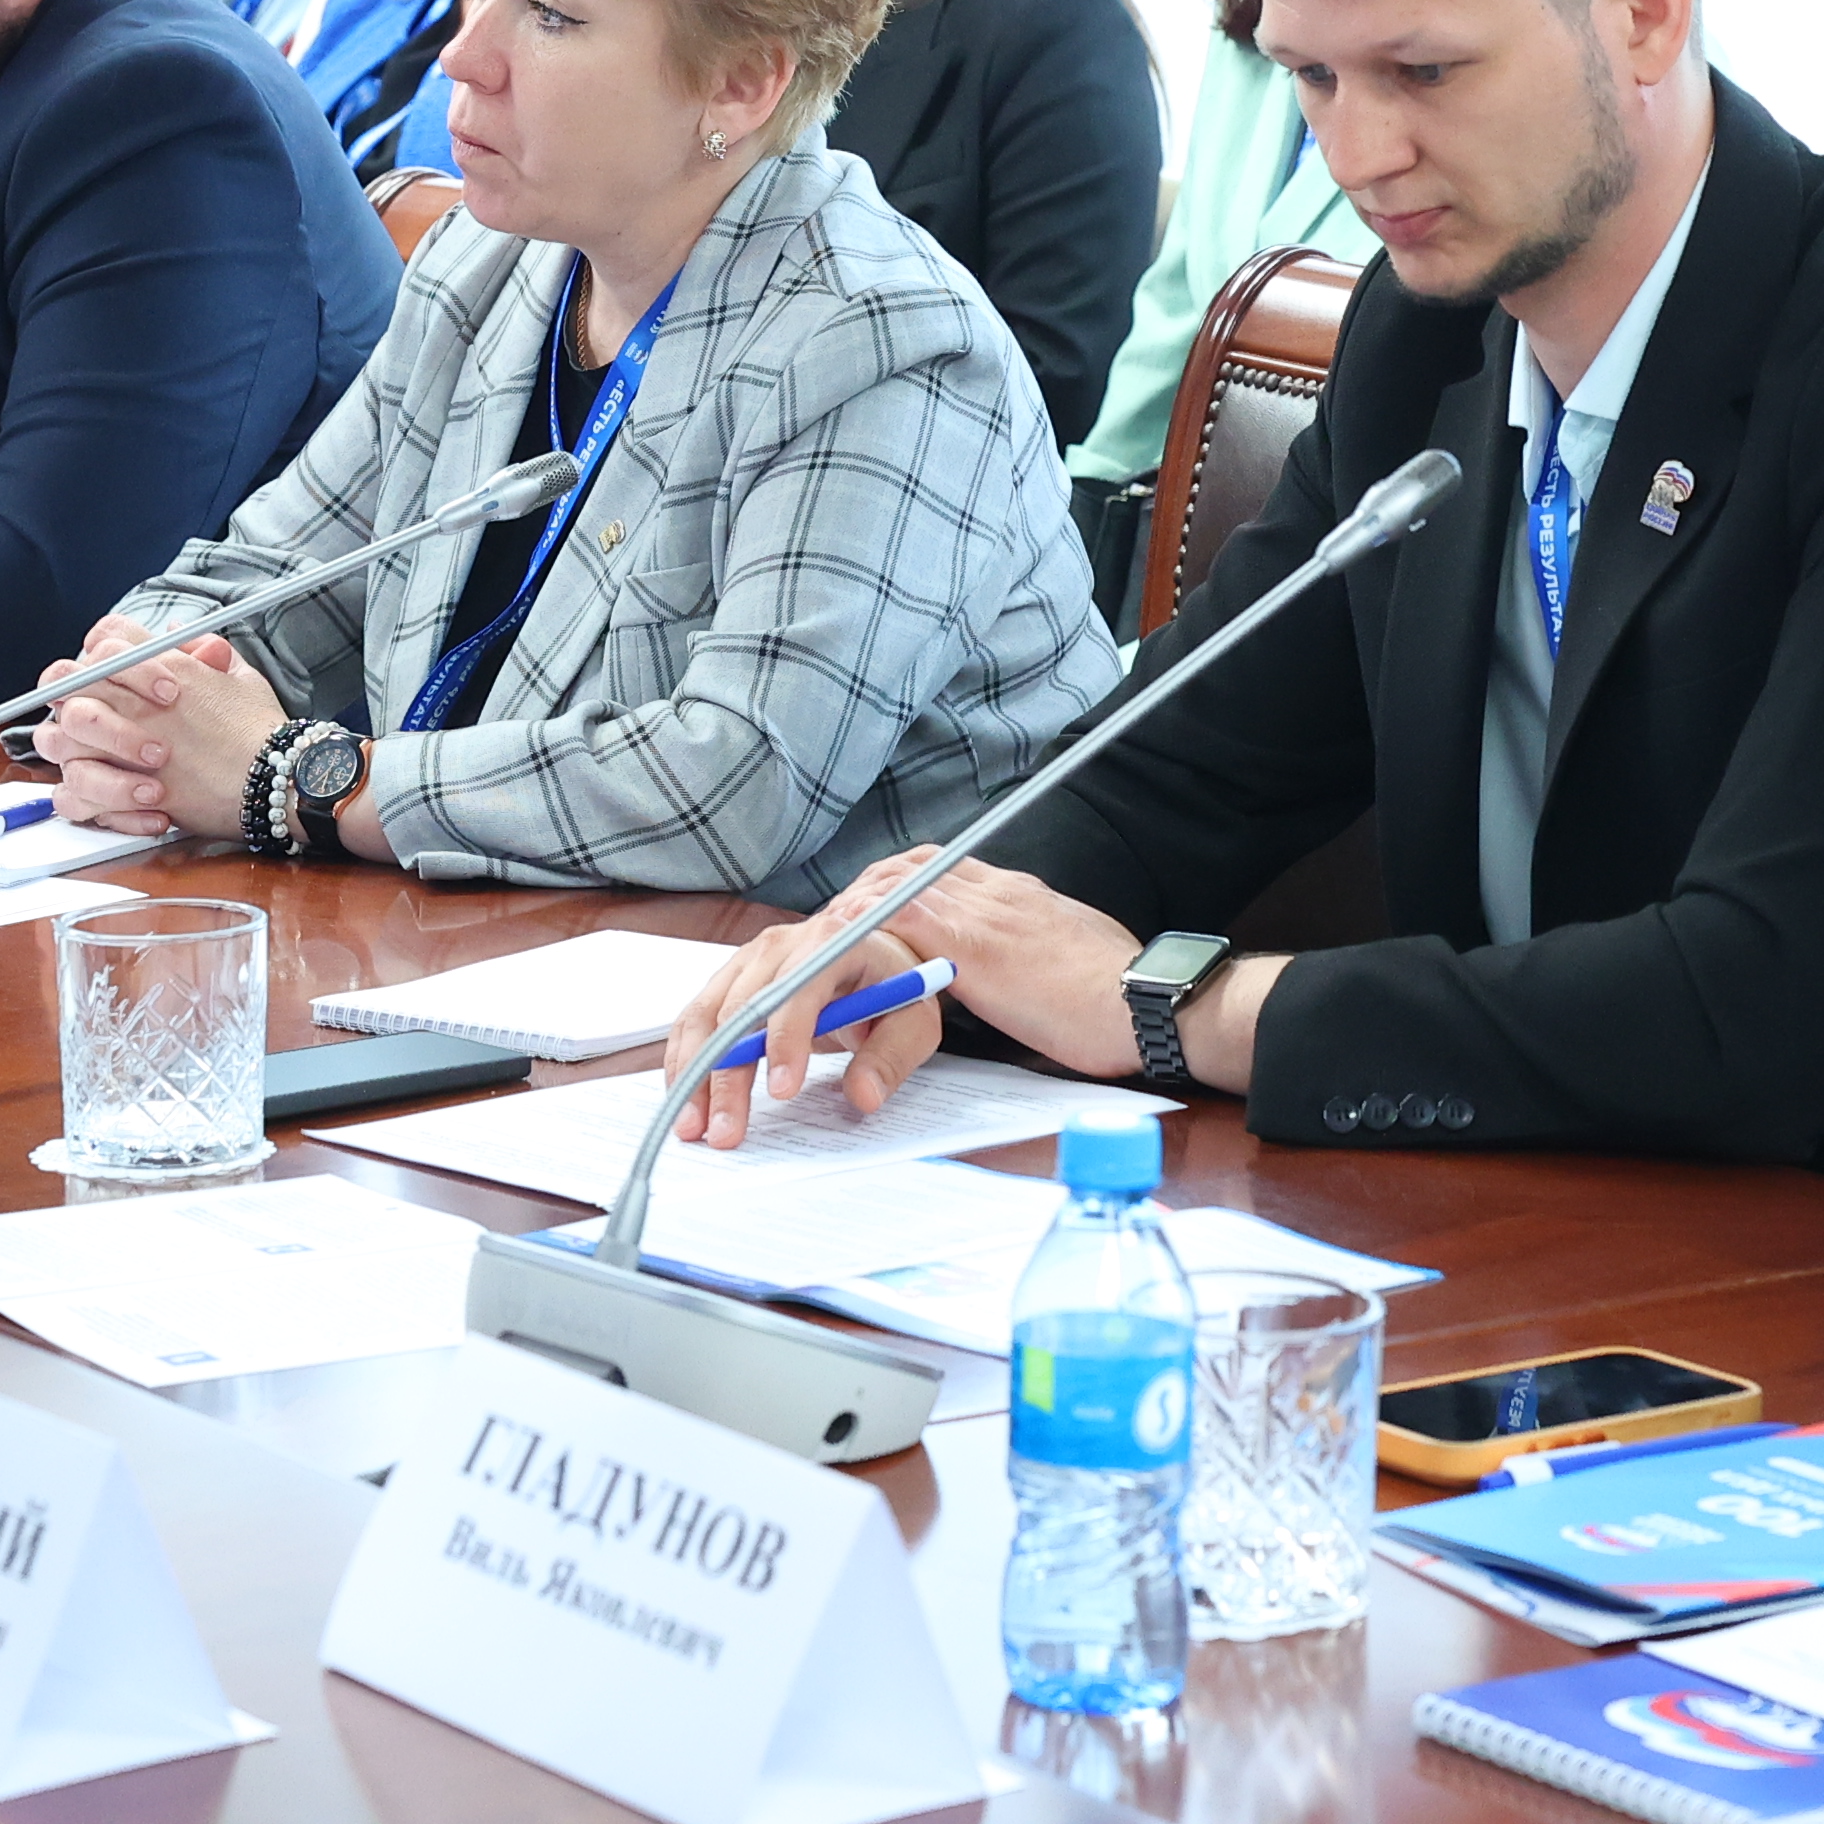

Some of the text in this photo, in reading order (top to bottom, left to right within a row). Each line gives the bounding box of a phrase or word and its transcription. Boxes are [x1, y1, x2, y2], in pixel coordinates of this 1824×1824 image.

[593, 378, 625, 434] «ЕСТЬ
[460, 1414, 789, 1594] ГЛАДУНОВ
[443, 1514, 725, 1669] Виль Яковлевич
